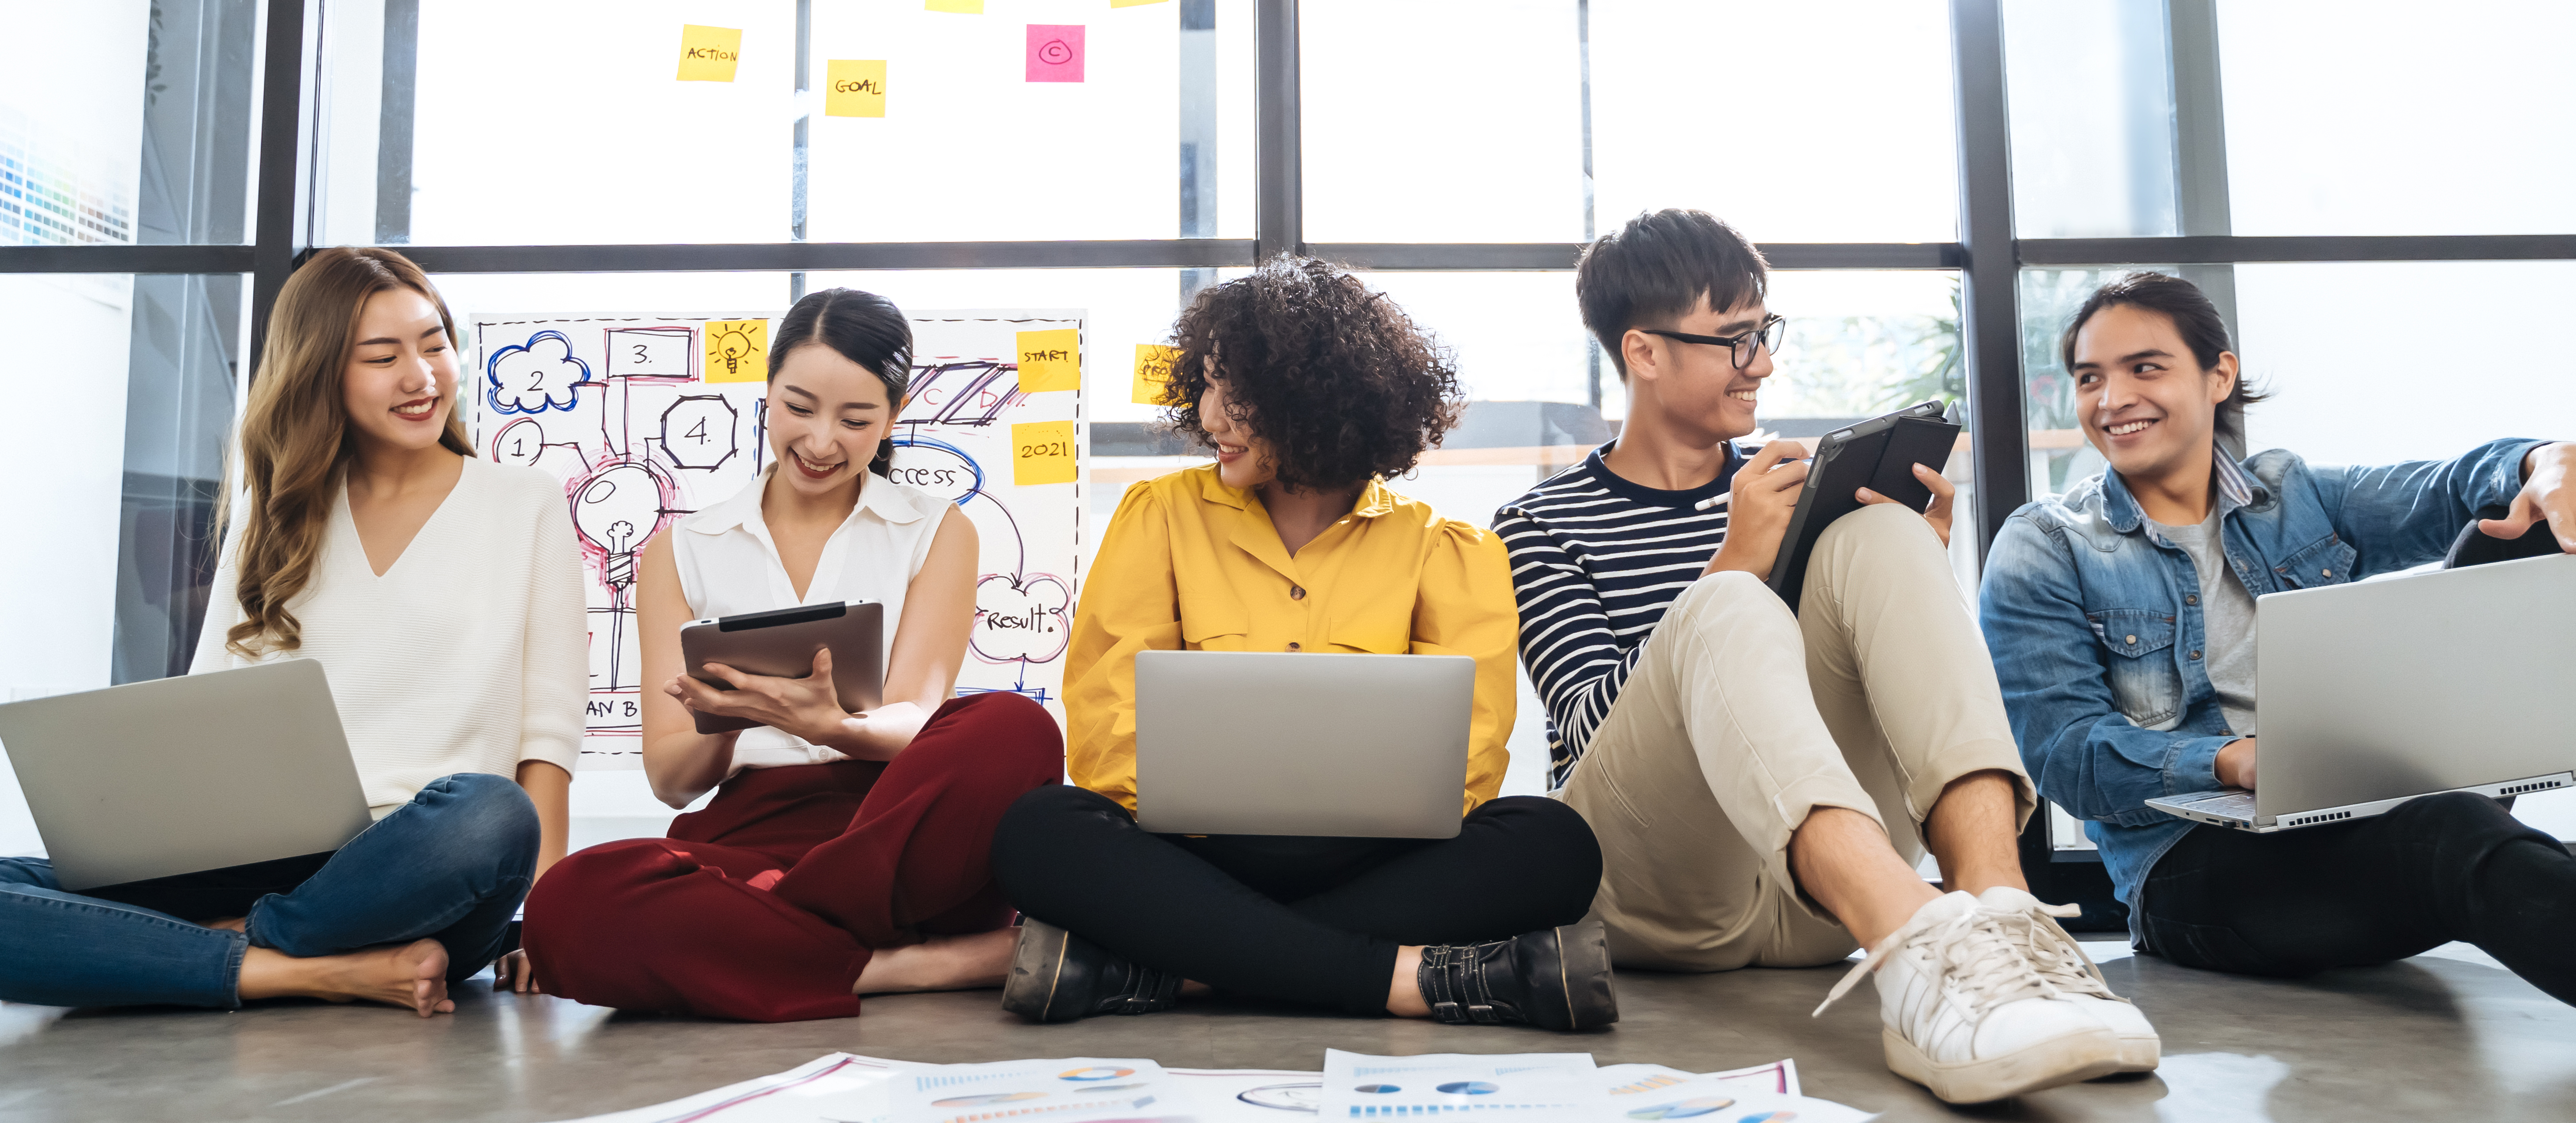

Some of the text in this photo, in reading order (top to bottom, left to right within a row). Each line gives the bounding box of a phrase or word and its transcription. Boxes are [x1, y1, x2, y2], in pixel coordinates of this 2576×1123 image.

[687, 47, 737, 62] ACTION
[836, 79, 882, 95] GOAL
[527, 371, 543, 391] 2
[924, 388, 943, 405] C
[511, 439, 525, 457] 1
[1021, 441, 1067, 458] 2021
[889, 468, 957, 487] ccess
[586, 700, 638, 718] AN B
